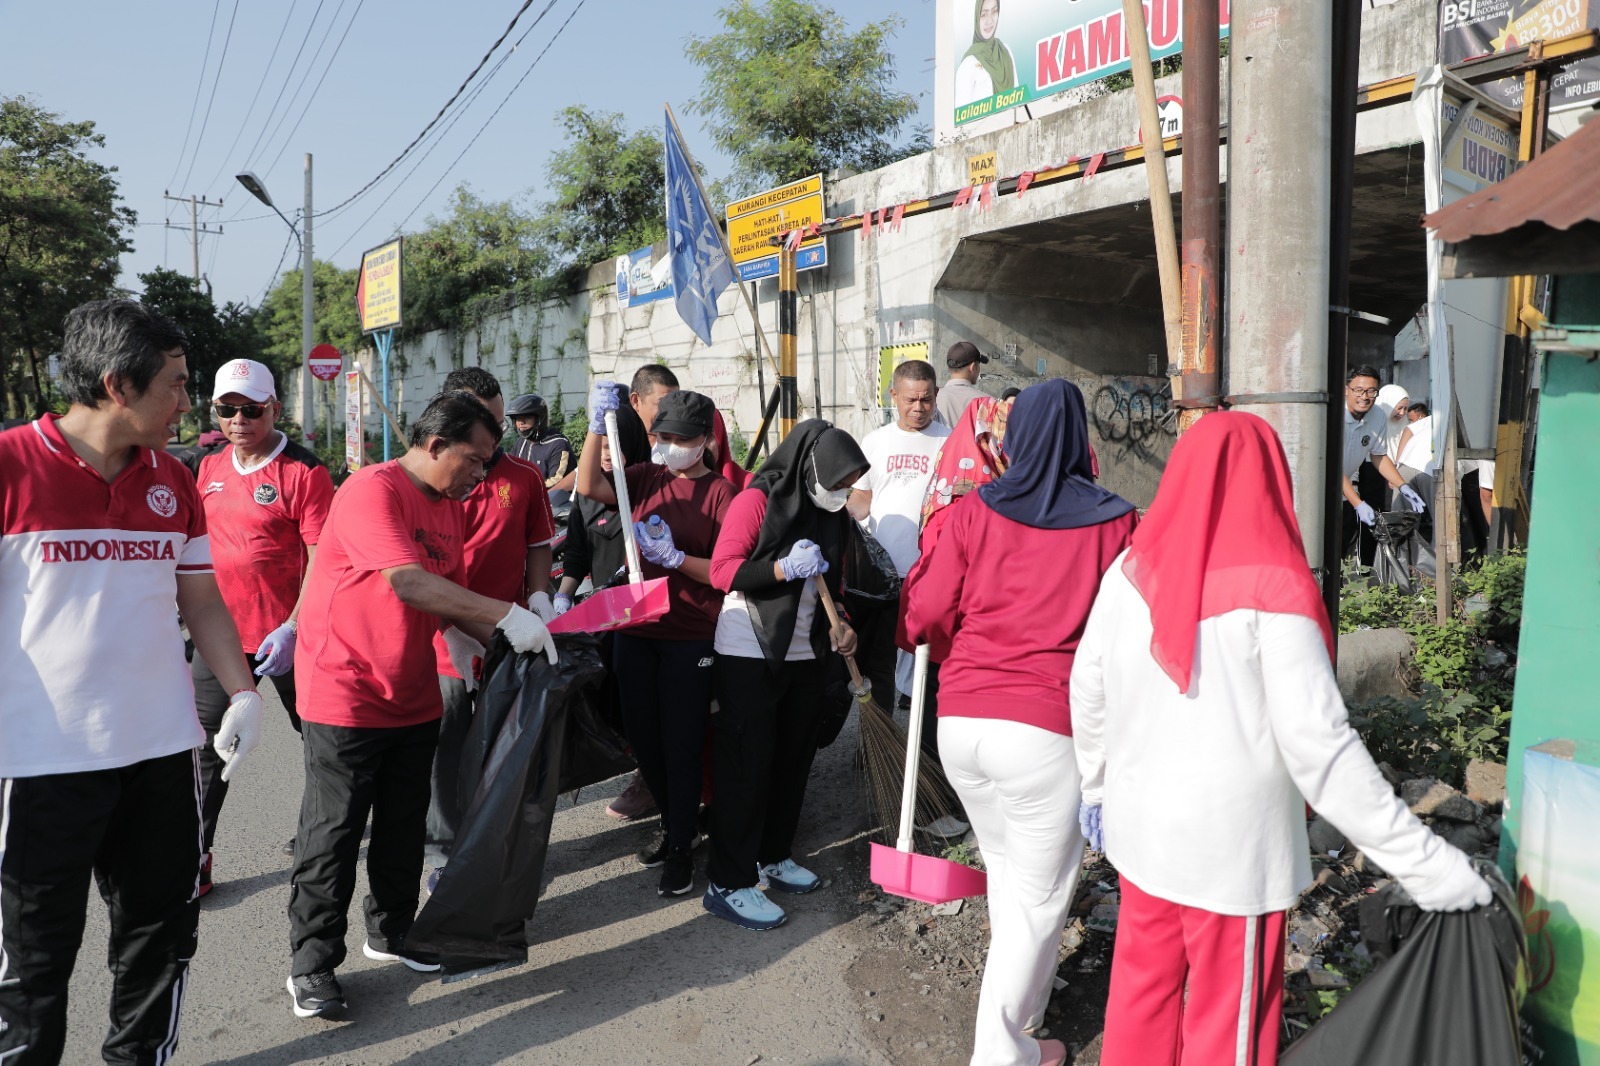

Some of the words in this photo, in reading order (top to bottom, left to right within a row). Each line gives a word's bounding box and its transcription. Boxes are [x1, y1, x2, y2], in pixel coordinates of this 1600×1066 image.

[1443, 0, 1477, 25] BSI
[1476, 2, 1510, 16] INDONESIA
[1486, 10, 1506, 20] BASRI
[1519, 26, 1539, 45] Rp
[1538, 0, 1580, 37] 300
[1553, 69, 1579, 88] CEPAT
[1565, 84, 1582, 98] INFO
[955, 98, 993, 123] Lailatul
[995, 87, 1025, 110] Badri
[971, 156, 995, 172] MAX
[737, 198, 767, 213] KURANGI
[768, 184, 808, 203] KECEPATAN
[738, 226, 775, 243] PERLINTASAN
[776, 219, 800, 232] KERETA
[801, 216, 812, 226] API
[733, 244, 755, 255] DAERAH
[886, 454, 930, 474] GUESS
[41, 539, 176, 562] INDONESIA
